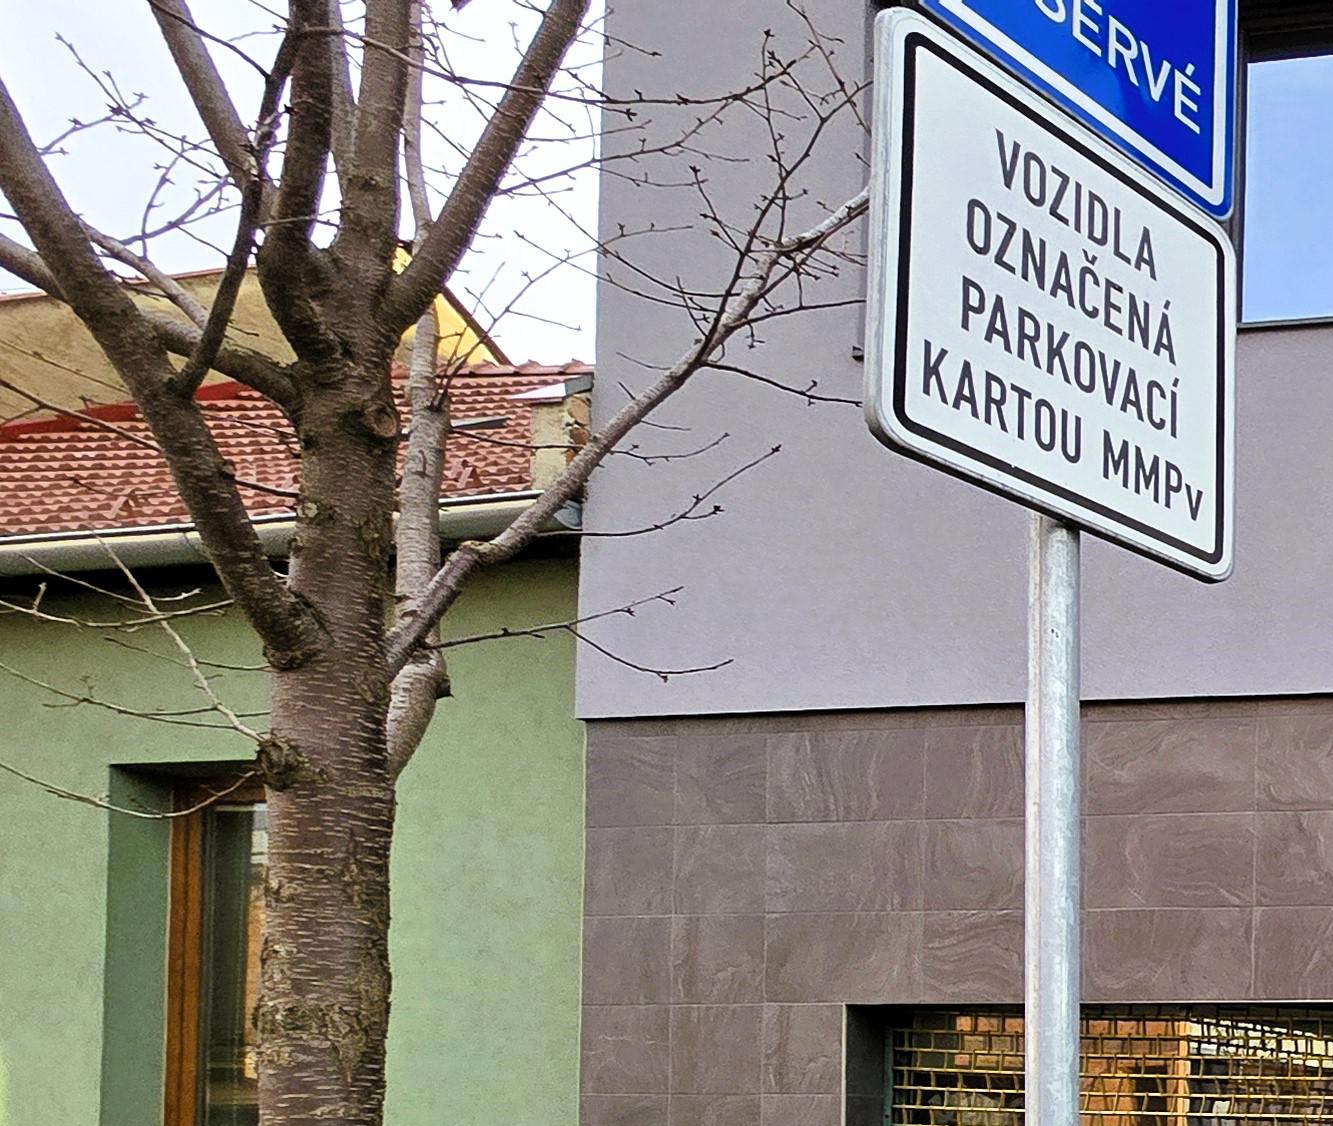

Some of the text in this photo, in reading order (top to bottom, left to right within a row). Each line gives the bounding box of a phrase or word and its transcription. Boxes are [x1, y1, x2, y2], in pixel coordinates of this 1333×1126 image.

[967, 198, 1177, 366] OZNAČENÁ
[995, 128, 1158, 281] VOZIDLA
[922, 339, 1203, 522] KARTOU MMPv
[960, 275, 1178, 439] PARKOVACÍ
